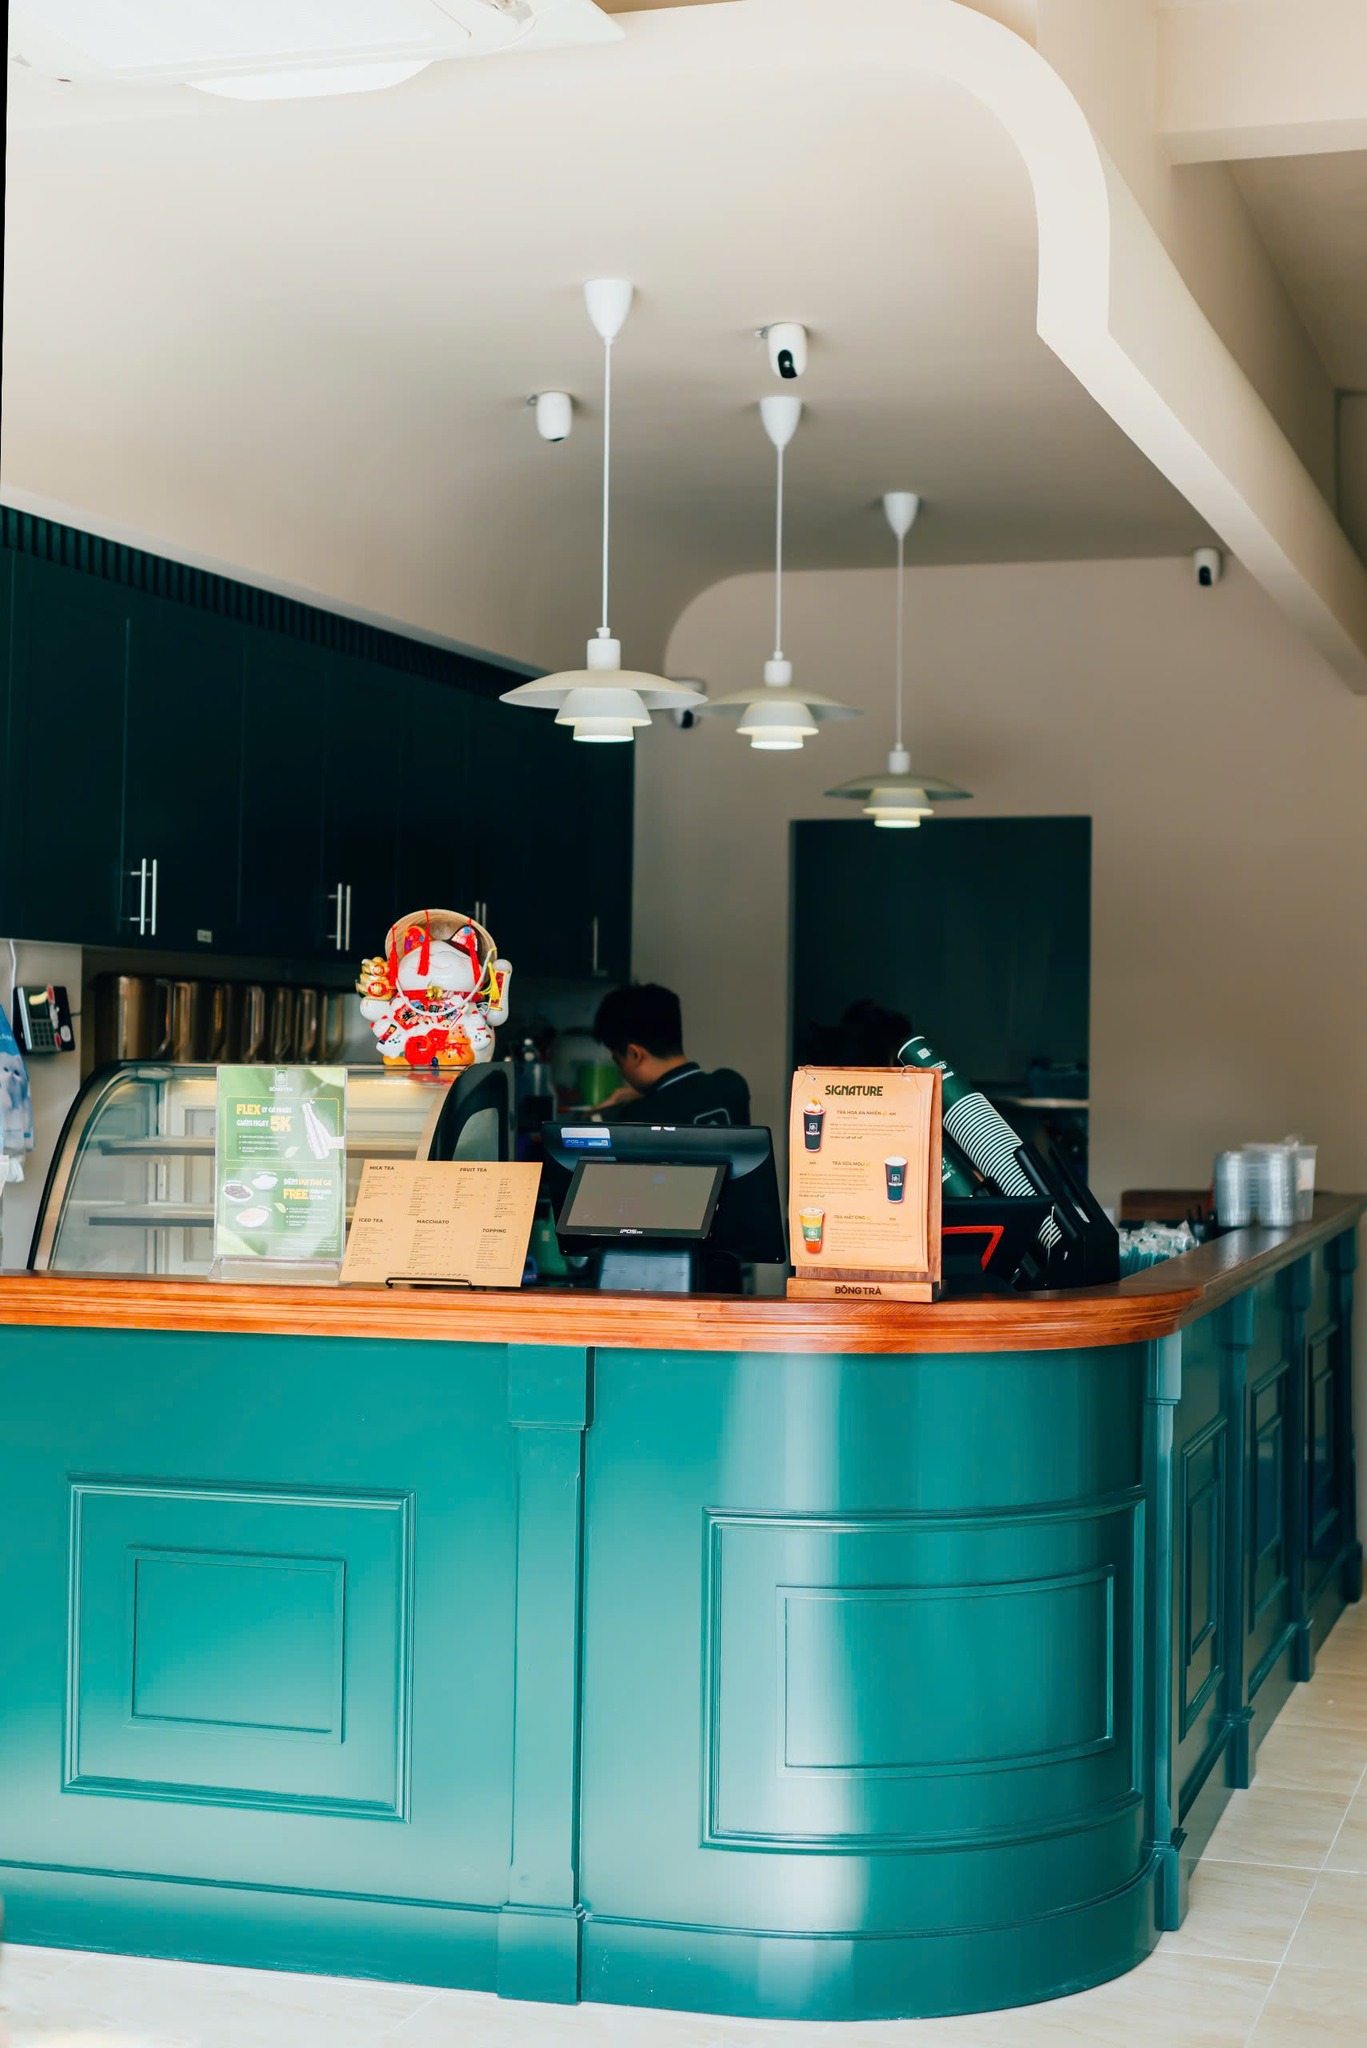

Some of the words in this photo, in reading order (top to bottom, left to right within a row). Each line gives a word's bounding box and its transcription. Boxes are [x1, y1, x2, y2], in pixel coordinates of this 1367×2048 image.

[825, 1085, 884, 1097] SIGNATURE
[236, 1104, 261, 1115] FLEX
[283, 1188, 309, 1200] FREE
[834, 1284, 862, 1295] BÔNG
[863, 1285, 882, 1296] TRÀ
